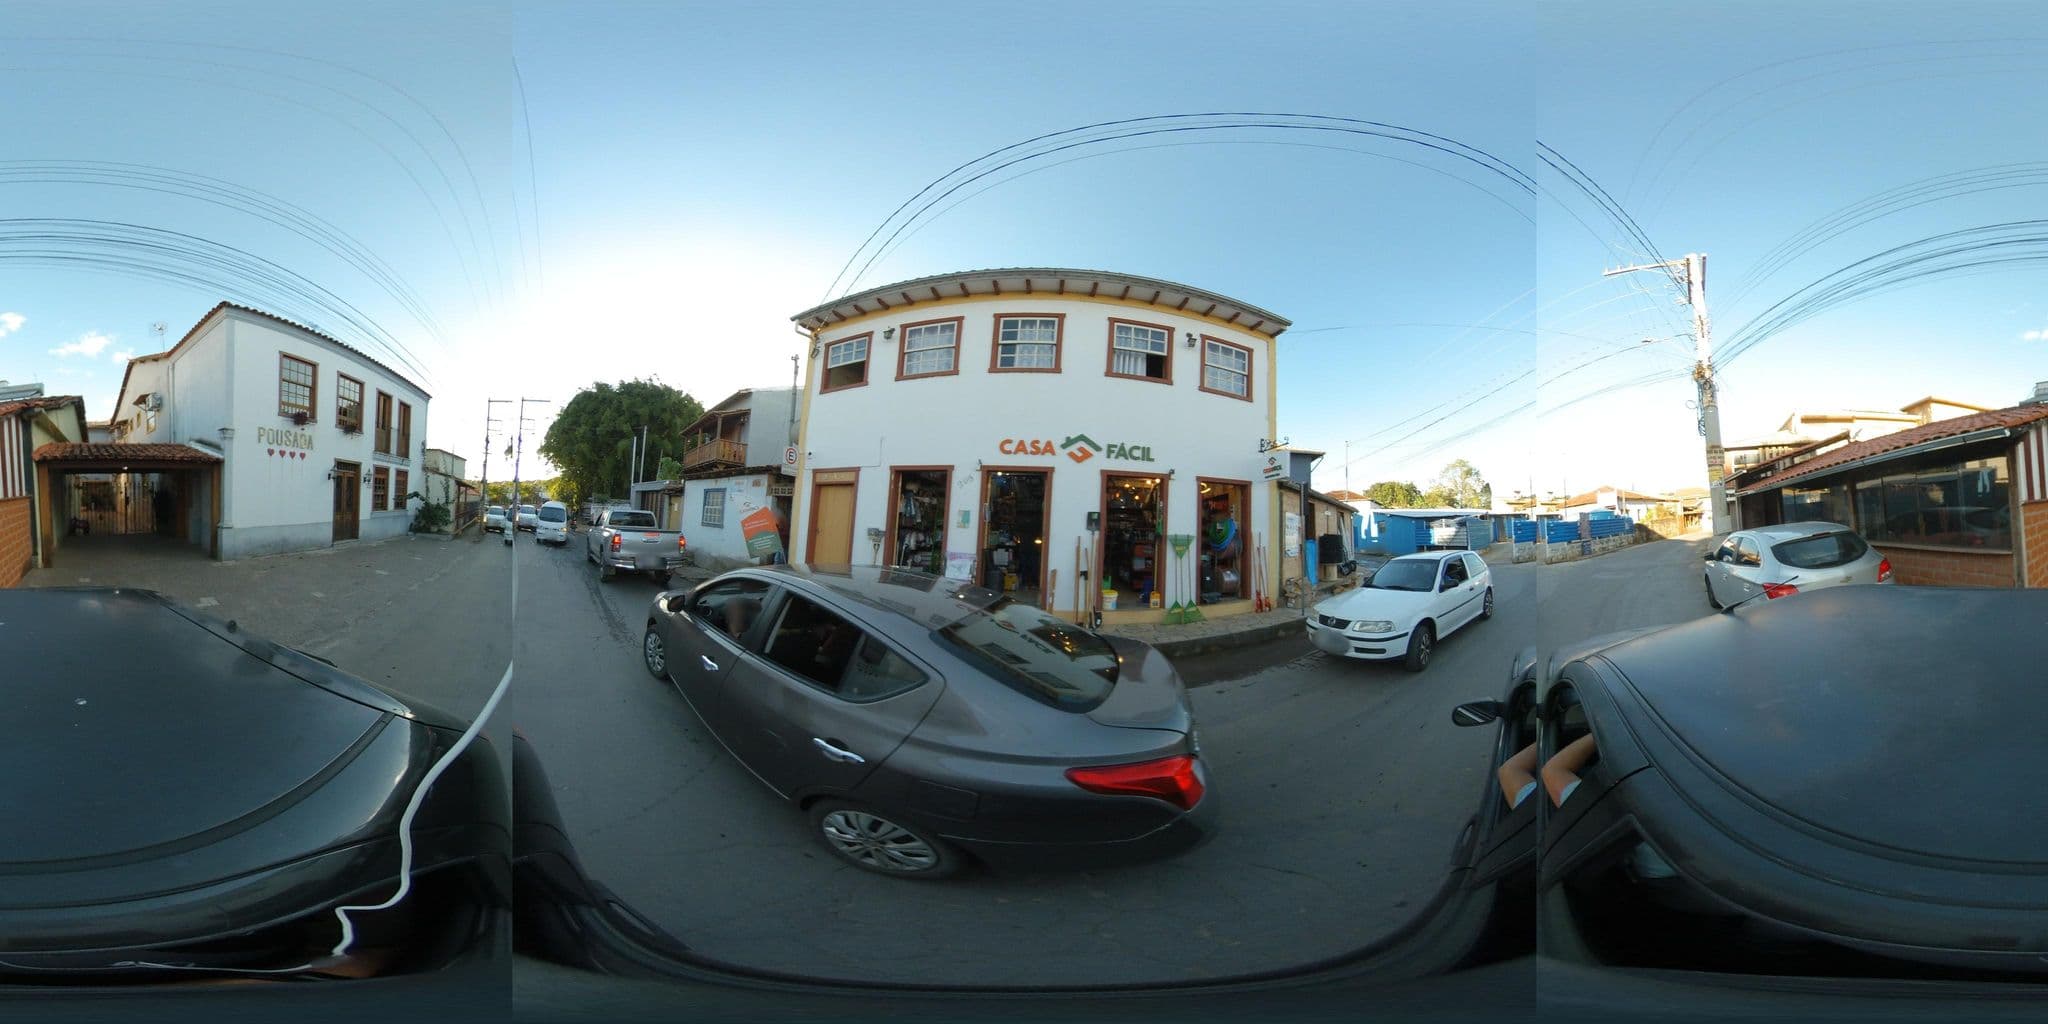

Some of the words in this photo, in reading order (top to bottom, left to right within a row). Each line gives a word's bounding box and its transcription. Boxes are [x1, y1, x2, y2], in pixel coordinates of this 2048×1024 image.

[257, 427, 314, 450] POUSADA
[999, 439, 1056, 456] CASA
[1106, 442, 1155, 462] FÁCIL
